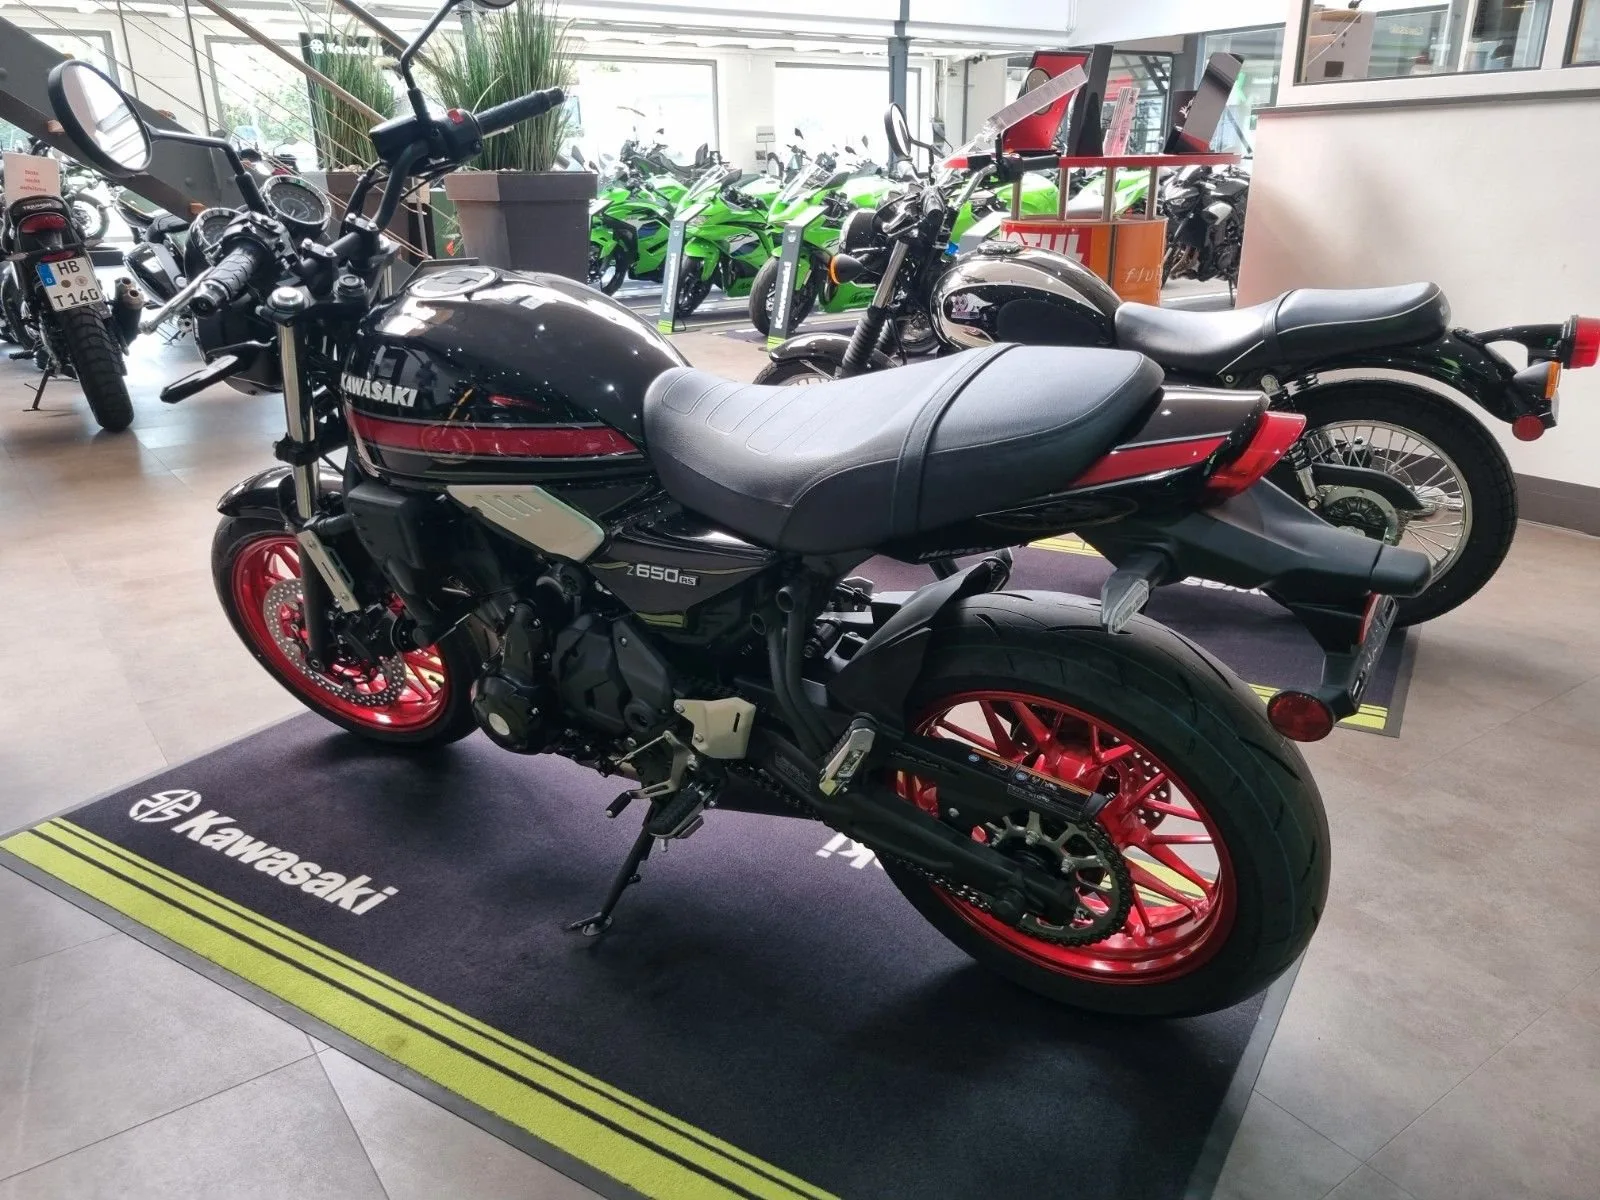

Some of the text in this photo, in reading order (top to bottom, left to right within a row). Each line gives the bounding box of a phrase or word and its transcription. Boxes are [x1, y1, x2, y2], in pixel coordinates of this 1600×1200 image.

[56, 259, 81, 276] HB
[341, 372, 418, 407] KAWASAKI
[171, 810, 400, 916] Kawasaki
